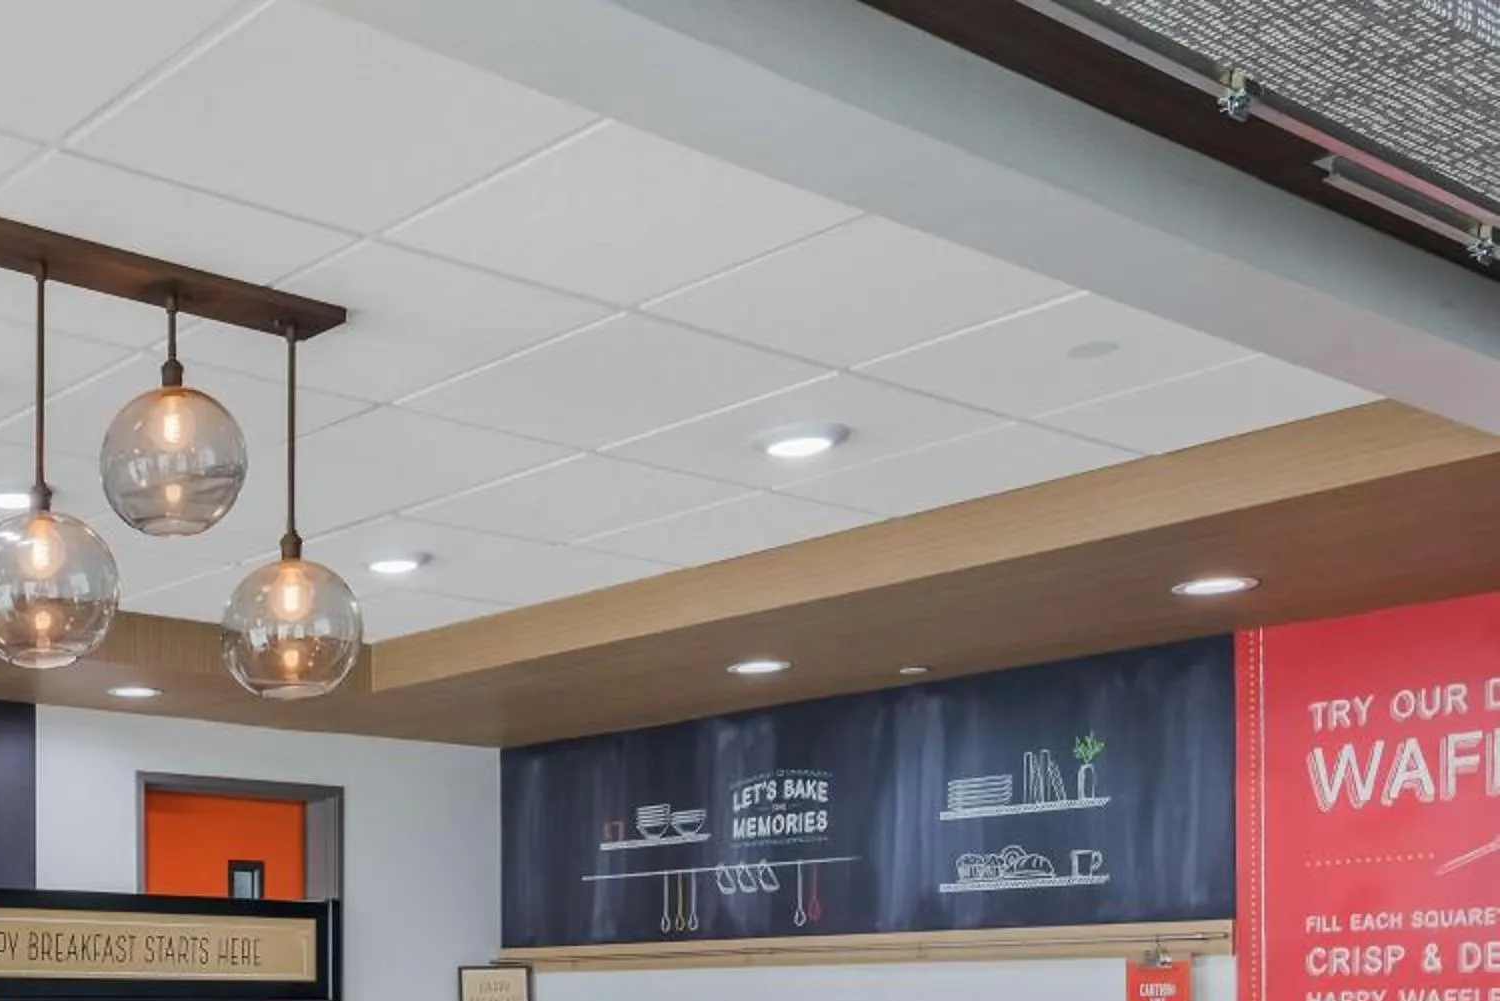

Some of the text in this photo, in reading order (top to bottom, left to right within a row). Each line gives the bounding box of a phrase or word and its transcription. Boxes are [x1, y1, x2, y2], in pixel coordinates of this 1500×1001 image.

[1308, 694, 1374, 732] TRY
[1390, 683, 1468, 722] OUR
[732, 779, 829, 813] LET'S BAKE
[732, 810, 828, 840] MEMORIES
[1305, 906, 1500, 935] FILL EACH SQUARE
[27, 931, 137, 964] BREAKFAST
[143, 934, 210, 966] STARTS
[217, 937, 263, 967] HERE
[1305, 944, 1406, 977] CRISP
[1422, 942, 1442, 973] &
